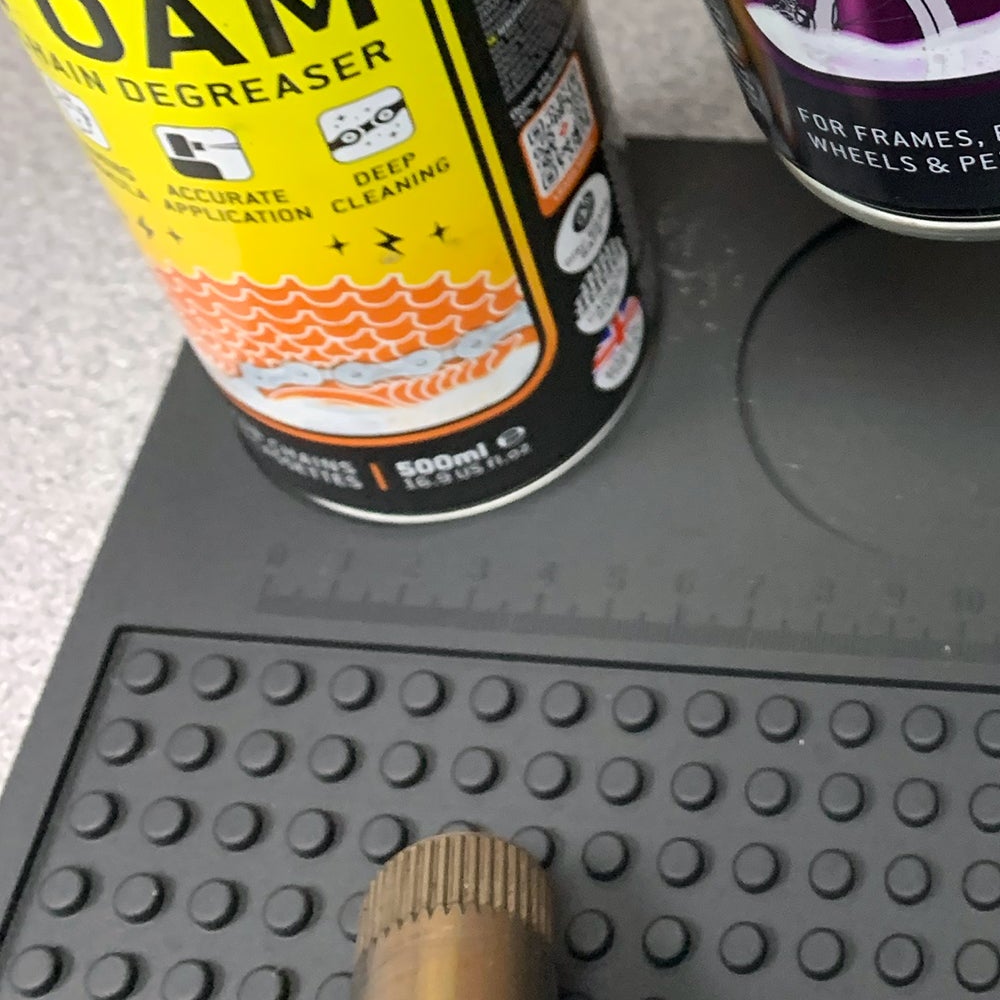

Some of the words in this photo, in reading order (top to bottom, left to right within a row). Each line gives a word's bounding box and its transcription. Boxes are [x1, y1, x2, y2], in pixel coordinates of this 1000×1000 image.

[116, 40, 392, 108] DEGREASER
[797, 106, 848, 137] FOR
[853, 124, 985, 150] FRAMES,
[353, 152, 417, 187] DEEP
[807, 132, 917, 174] WHEELS
[927, 156, 951, 174] &
[168, 184, 290, 206] ACCURATE
[331, 156, 451, 214] CLEANING
[165, 199, 313, 224] APPLICATION
